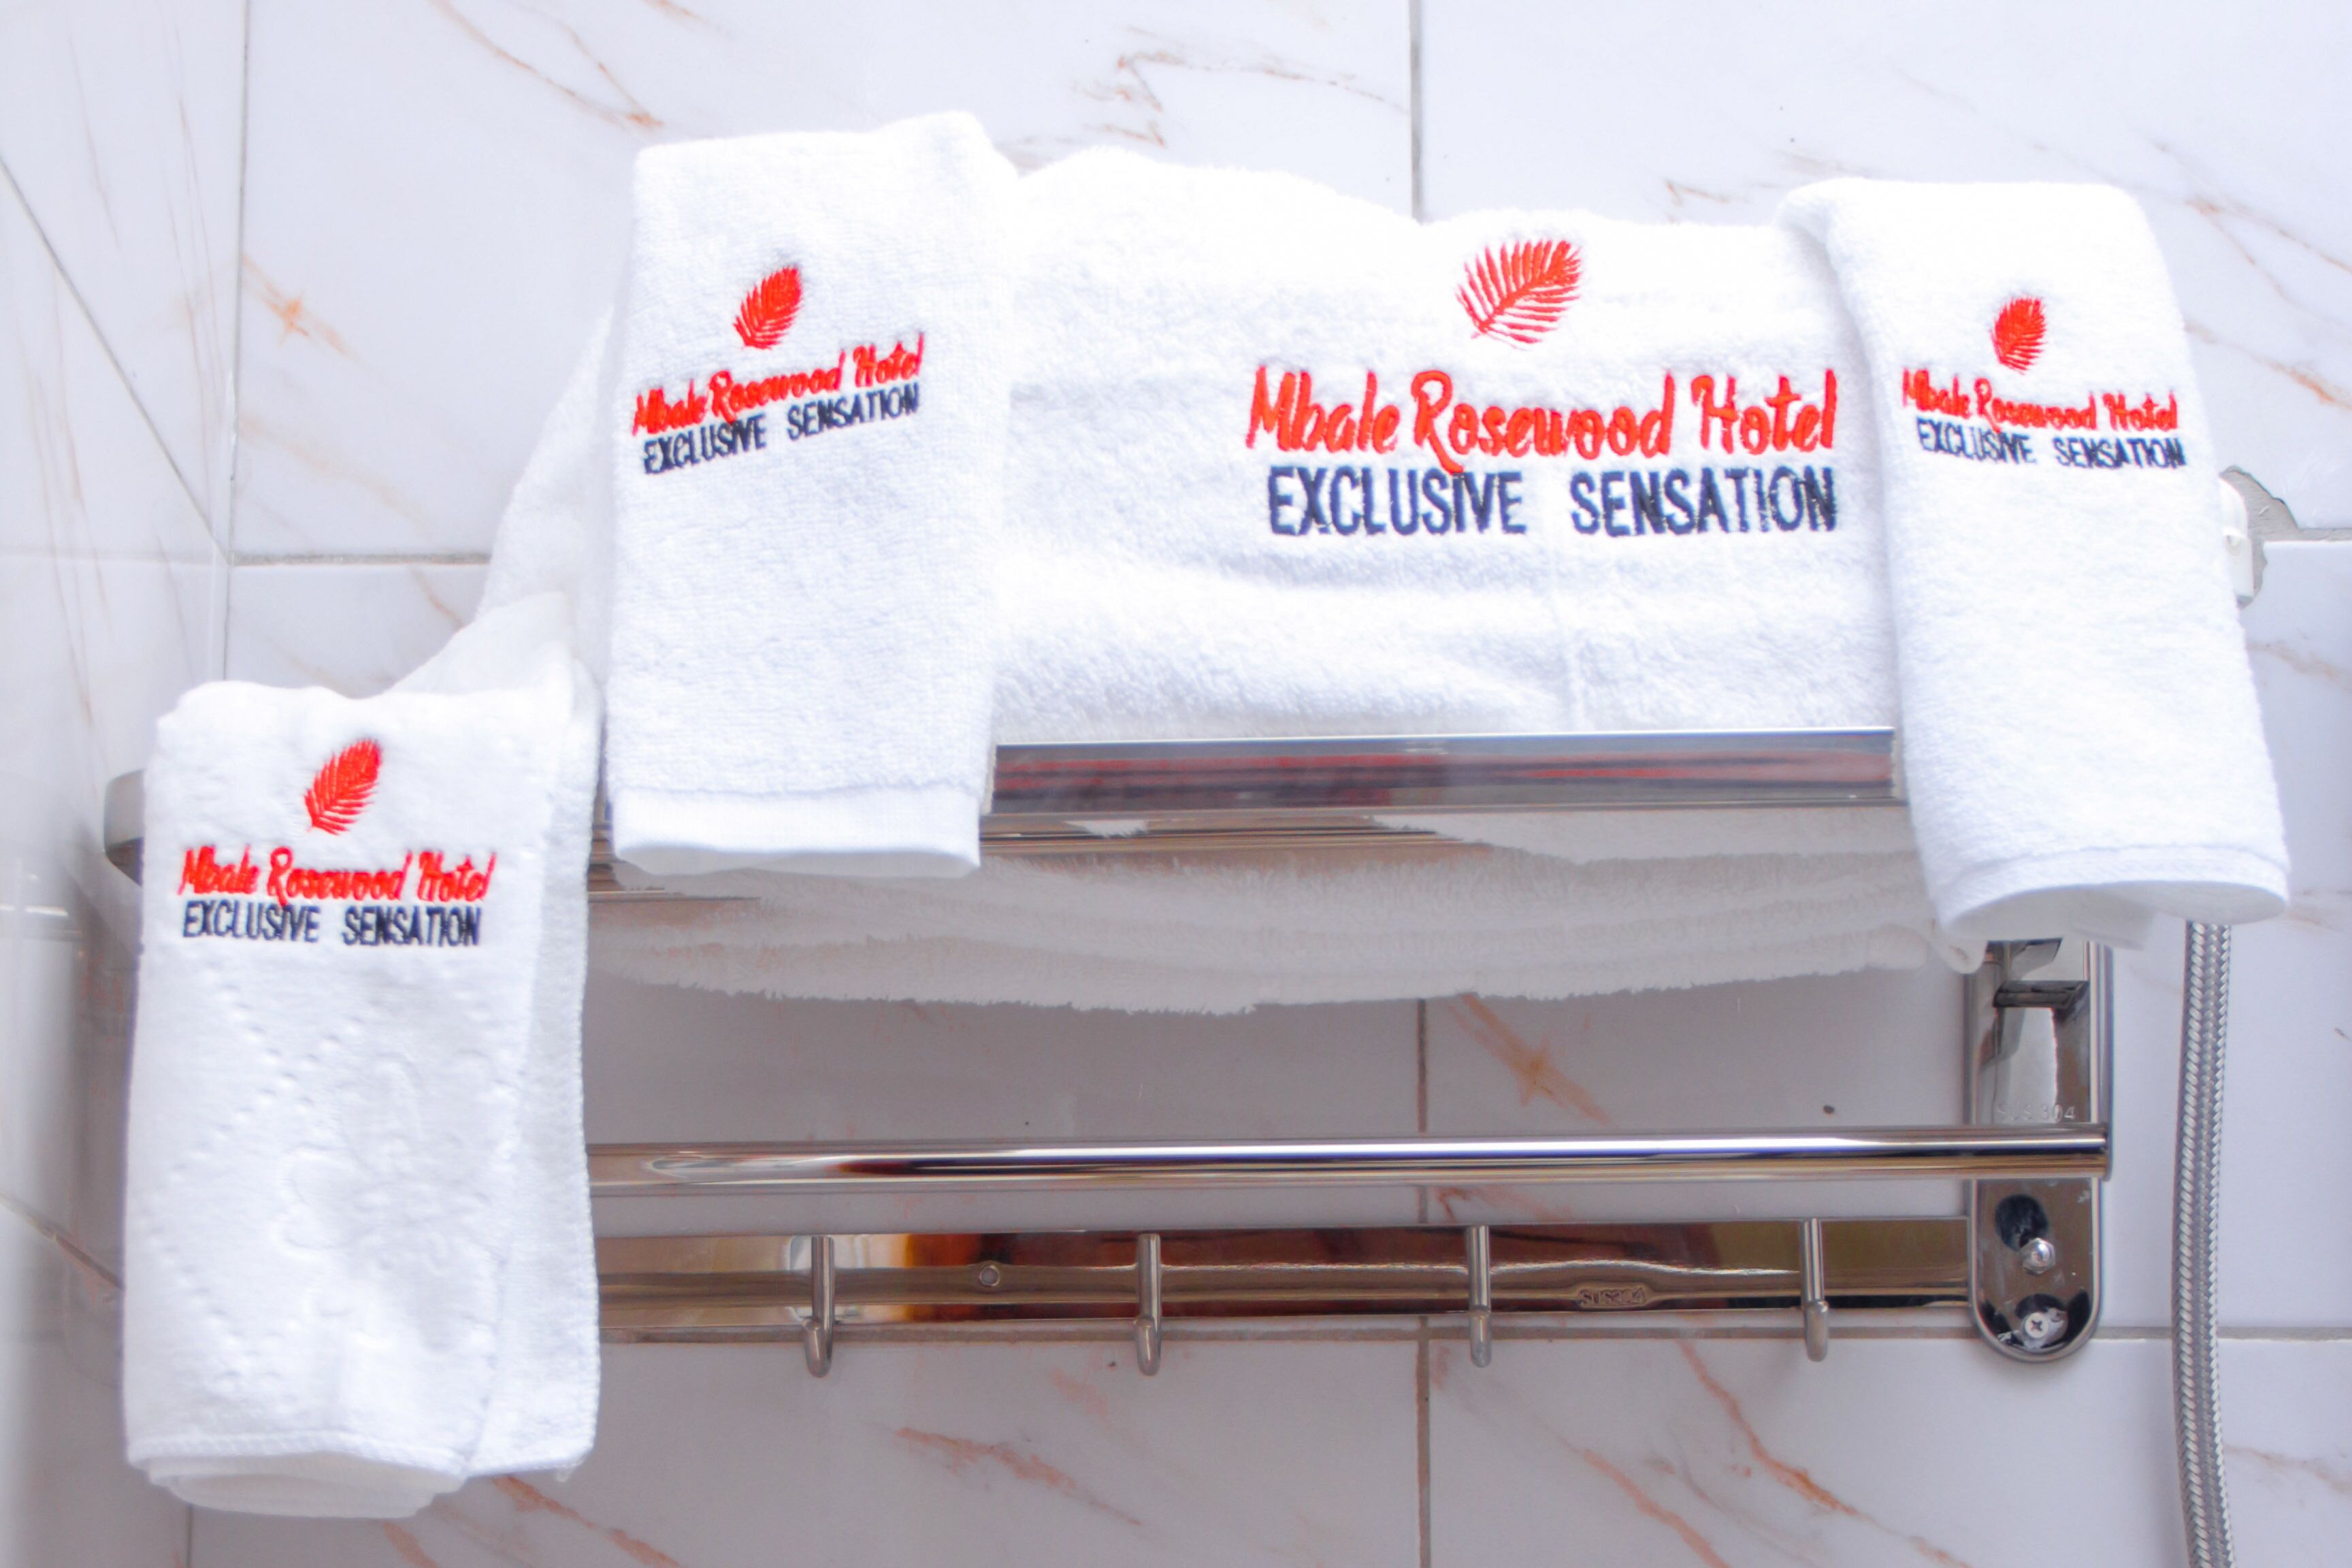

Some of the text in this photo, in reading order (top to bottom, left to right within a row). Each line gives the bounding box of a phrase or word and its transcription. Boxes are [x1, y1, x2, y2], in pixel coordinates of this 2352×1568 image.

[632, 331, 924, 436] Mbale Rosewood Hotel
[1902, 367, 2178, 434] Mbale Rosewood Hotel
[642, 381, 919, 475] EXCLUSIVE SENSATION
[1245, 365, 1838, 476] Mbale Rosewood Hotel
[1916, 416, 2187, 469] EXCLUSIVE SENSATION
[1267, 464, 1840, 537] EXCLUSIVE SENSATION
[178, 845, 497, 907] Mbale Rosewood Hotel
[182, 898, 482, 948] EXCLUSIVE SENSATION
[2042, 1103, 2076, 1122] 304
